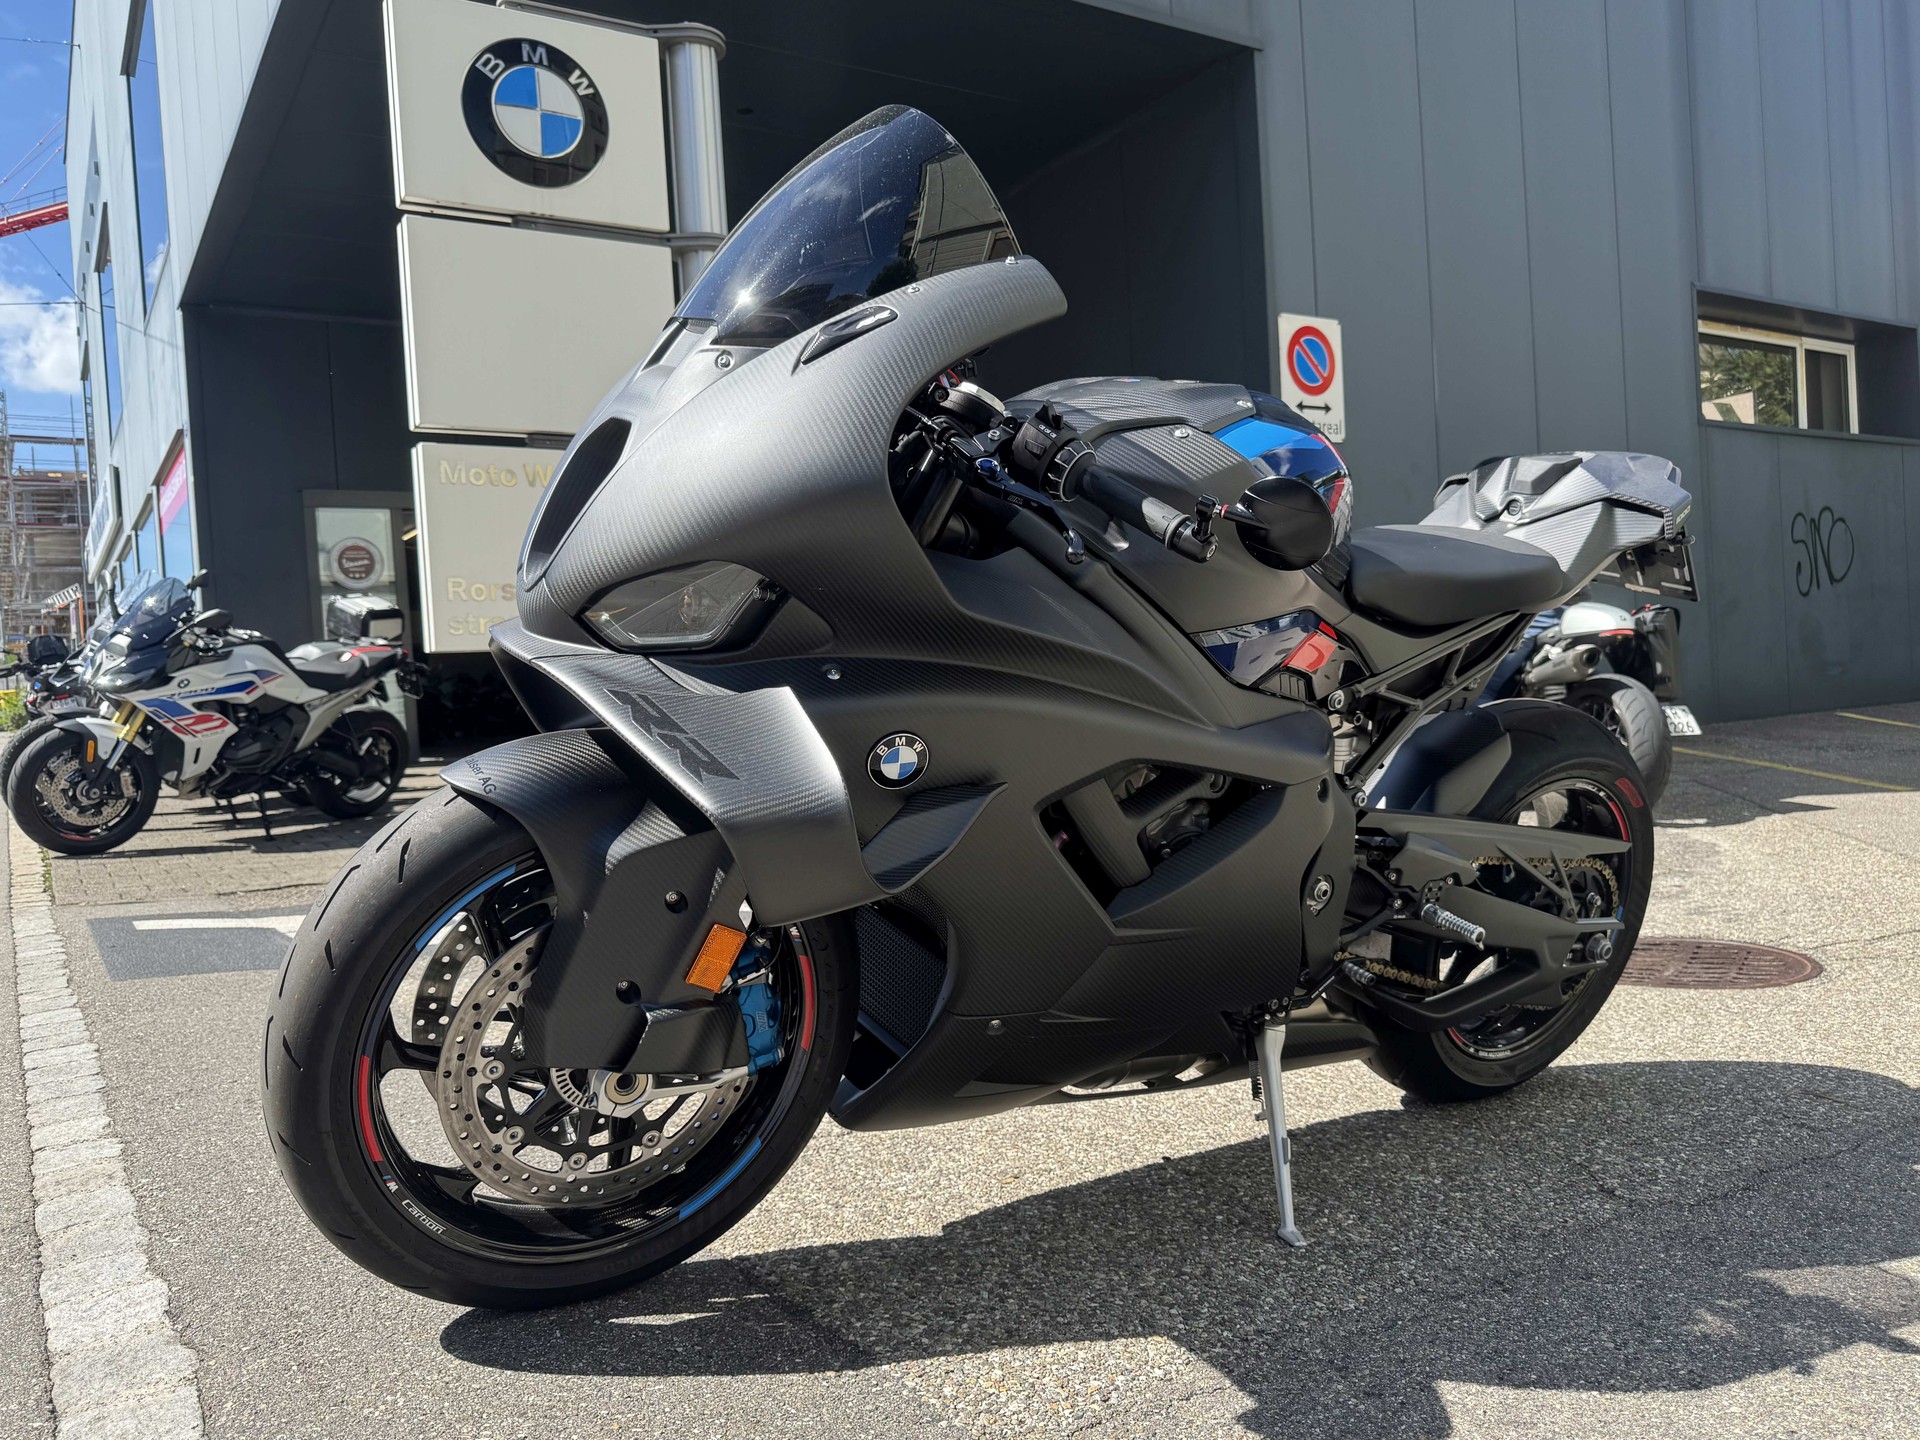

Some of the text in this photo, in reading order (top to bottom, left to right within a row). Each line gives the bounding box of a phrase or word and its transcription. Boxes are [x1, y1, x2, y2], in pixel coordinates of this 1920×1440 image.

[475, 41, 594, 96] BMW
[440, 460, 518, 487] Moto
[447, 577, 516, 602] Rors
[603, 686, 741, 788] RR
[876, 736, 925, 757] BMW
[478, 776, 497, 795] AG
[402, 1199, 447, 1235] Carbon
